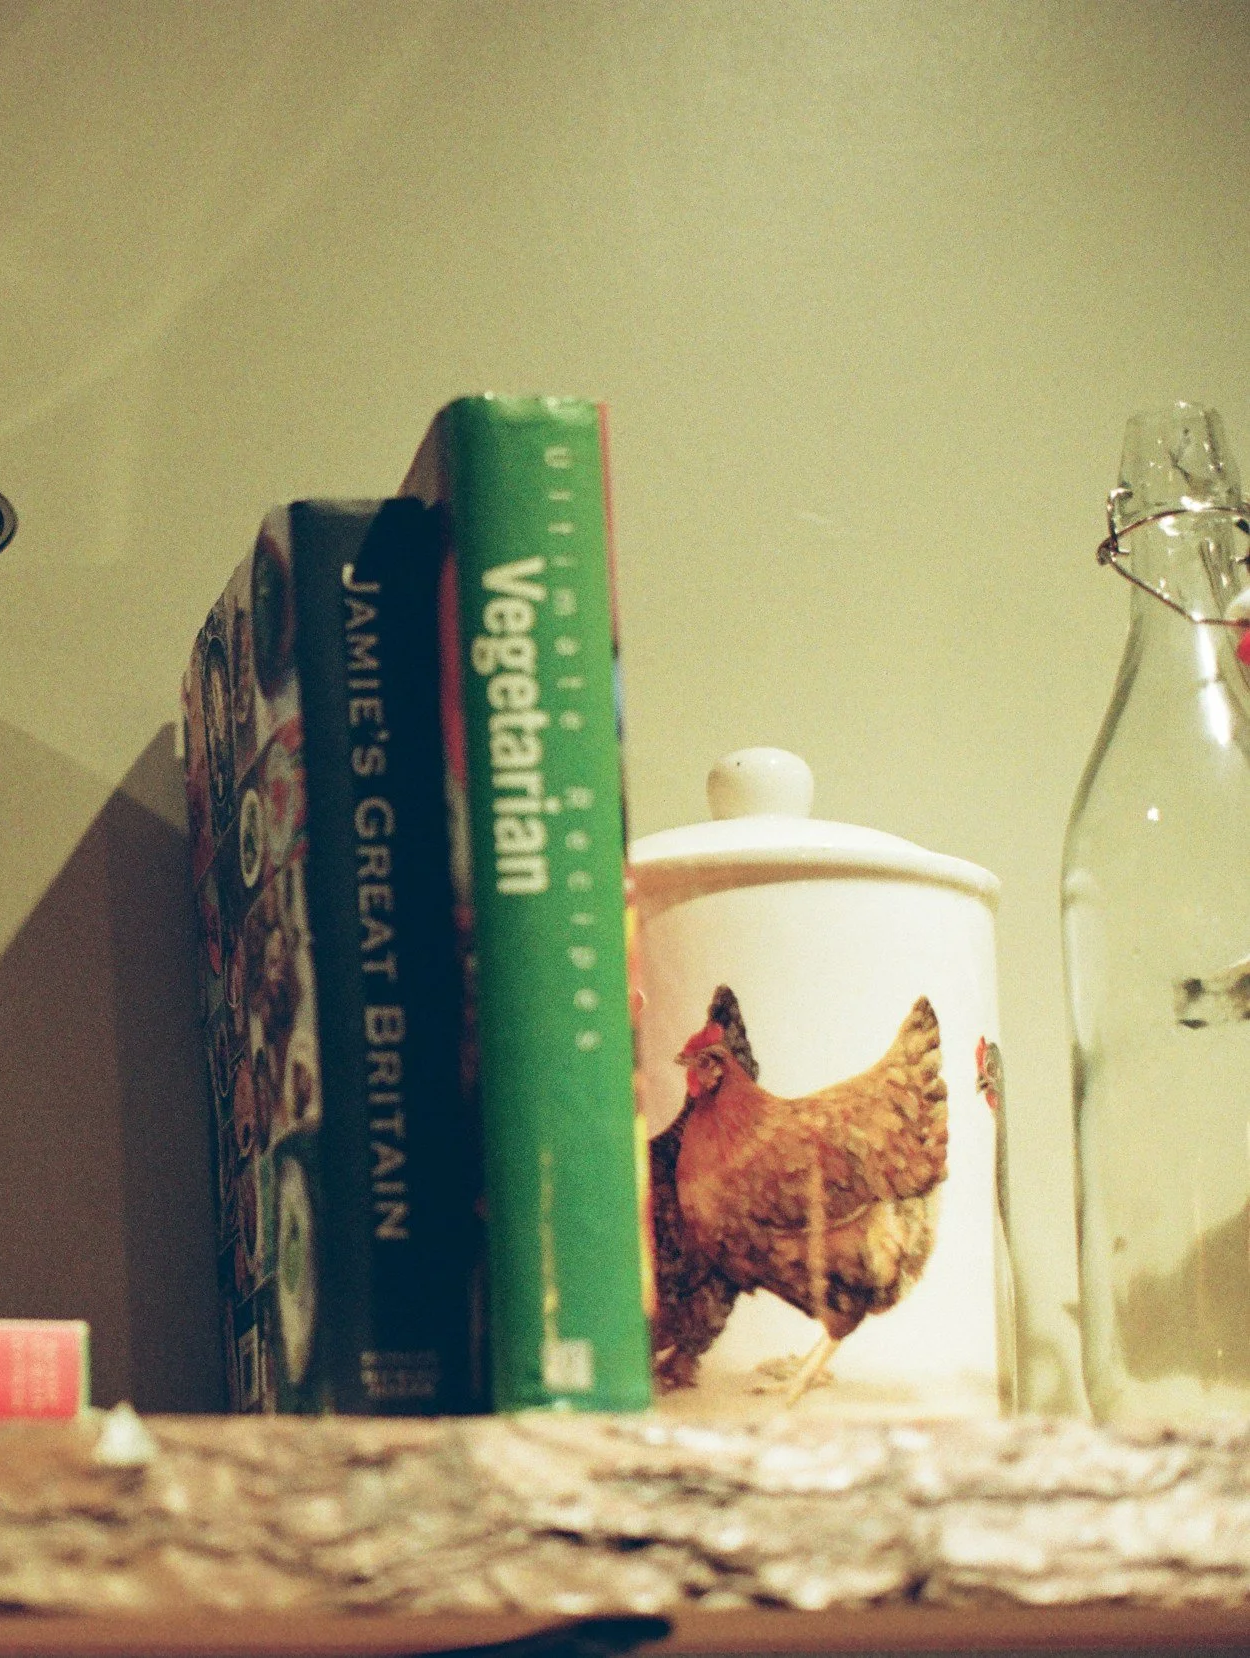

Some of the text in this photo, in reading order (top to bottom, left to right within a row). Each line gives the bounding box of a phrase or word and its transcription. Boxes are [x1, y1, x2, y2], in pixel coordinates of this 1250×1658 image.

[340, 562, 412, 1242] JAMIE'S GREAT BRITAIN
[470, 556, 552, 896] Vegetarian
